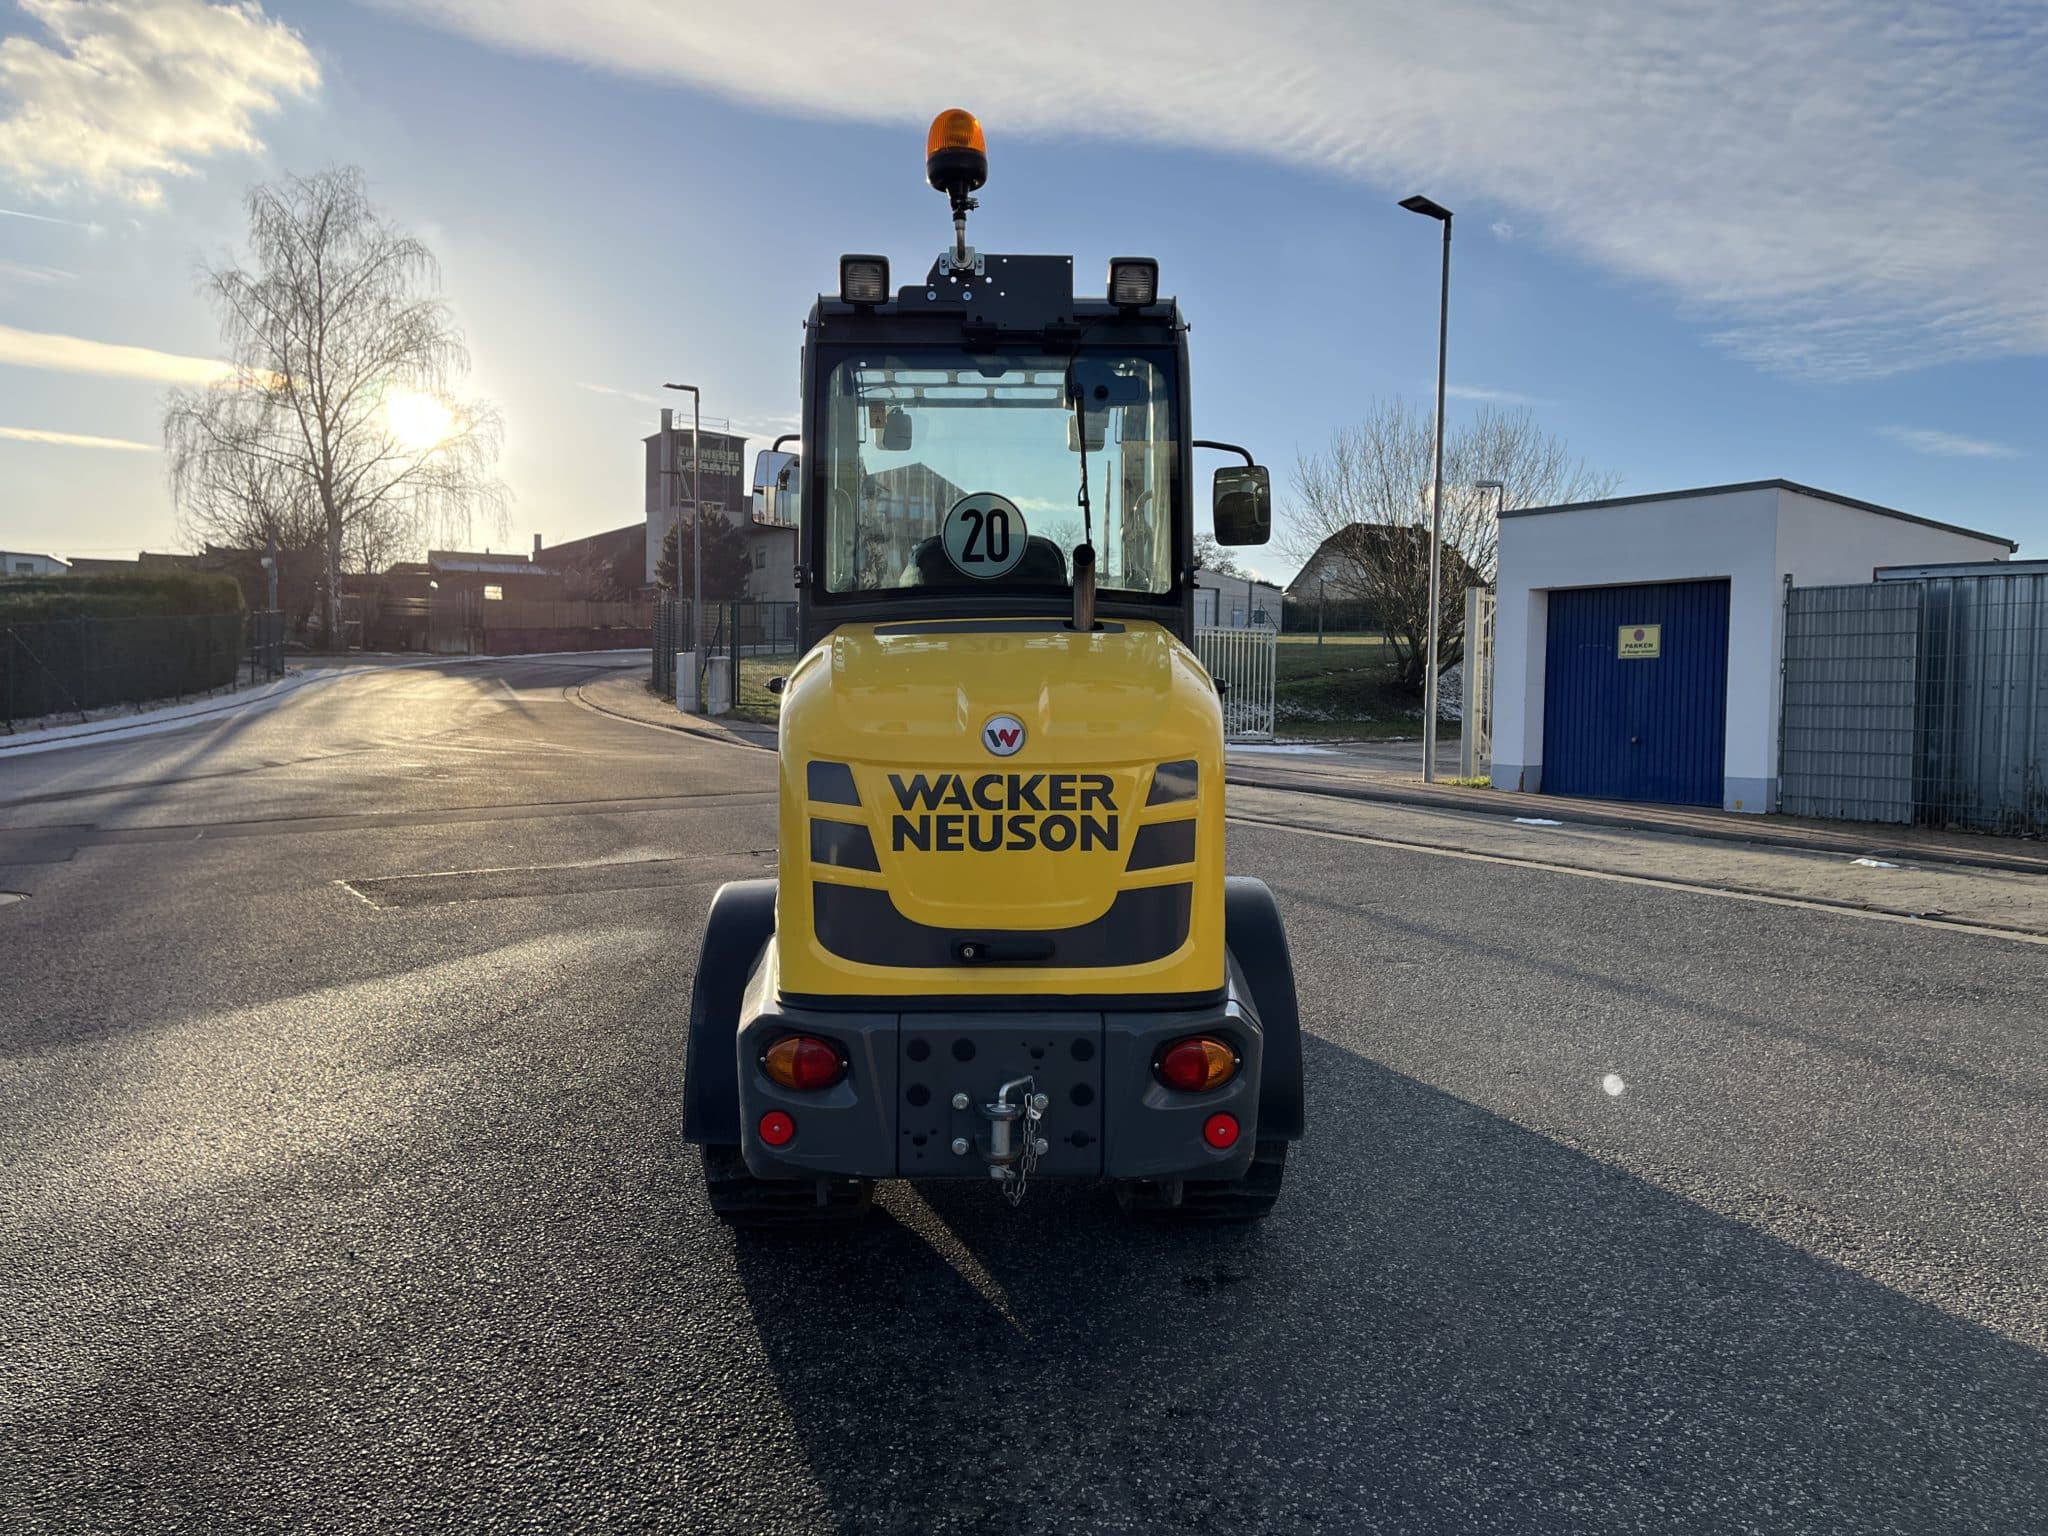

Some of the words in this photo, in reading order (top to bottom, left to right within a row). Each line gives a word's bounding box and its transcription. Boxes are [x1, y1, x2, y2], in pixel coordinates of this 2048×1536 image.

[961, 508, 1010, 563] 20
[887, 774, 1119, 811] WACKER
[892, 814, 1119, 852] NEUSON
